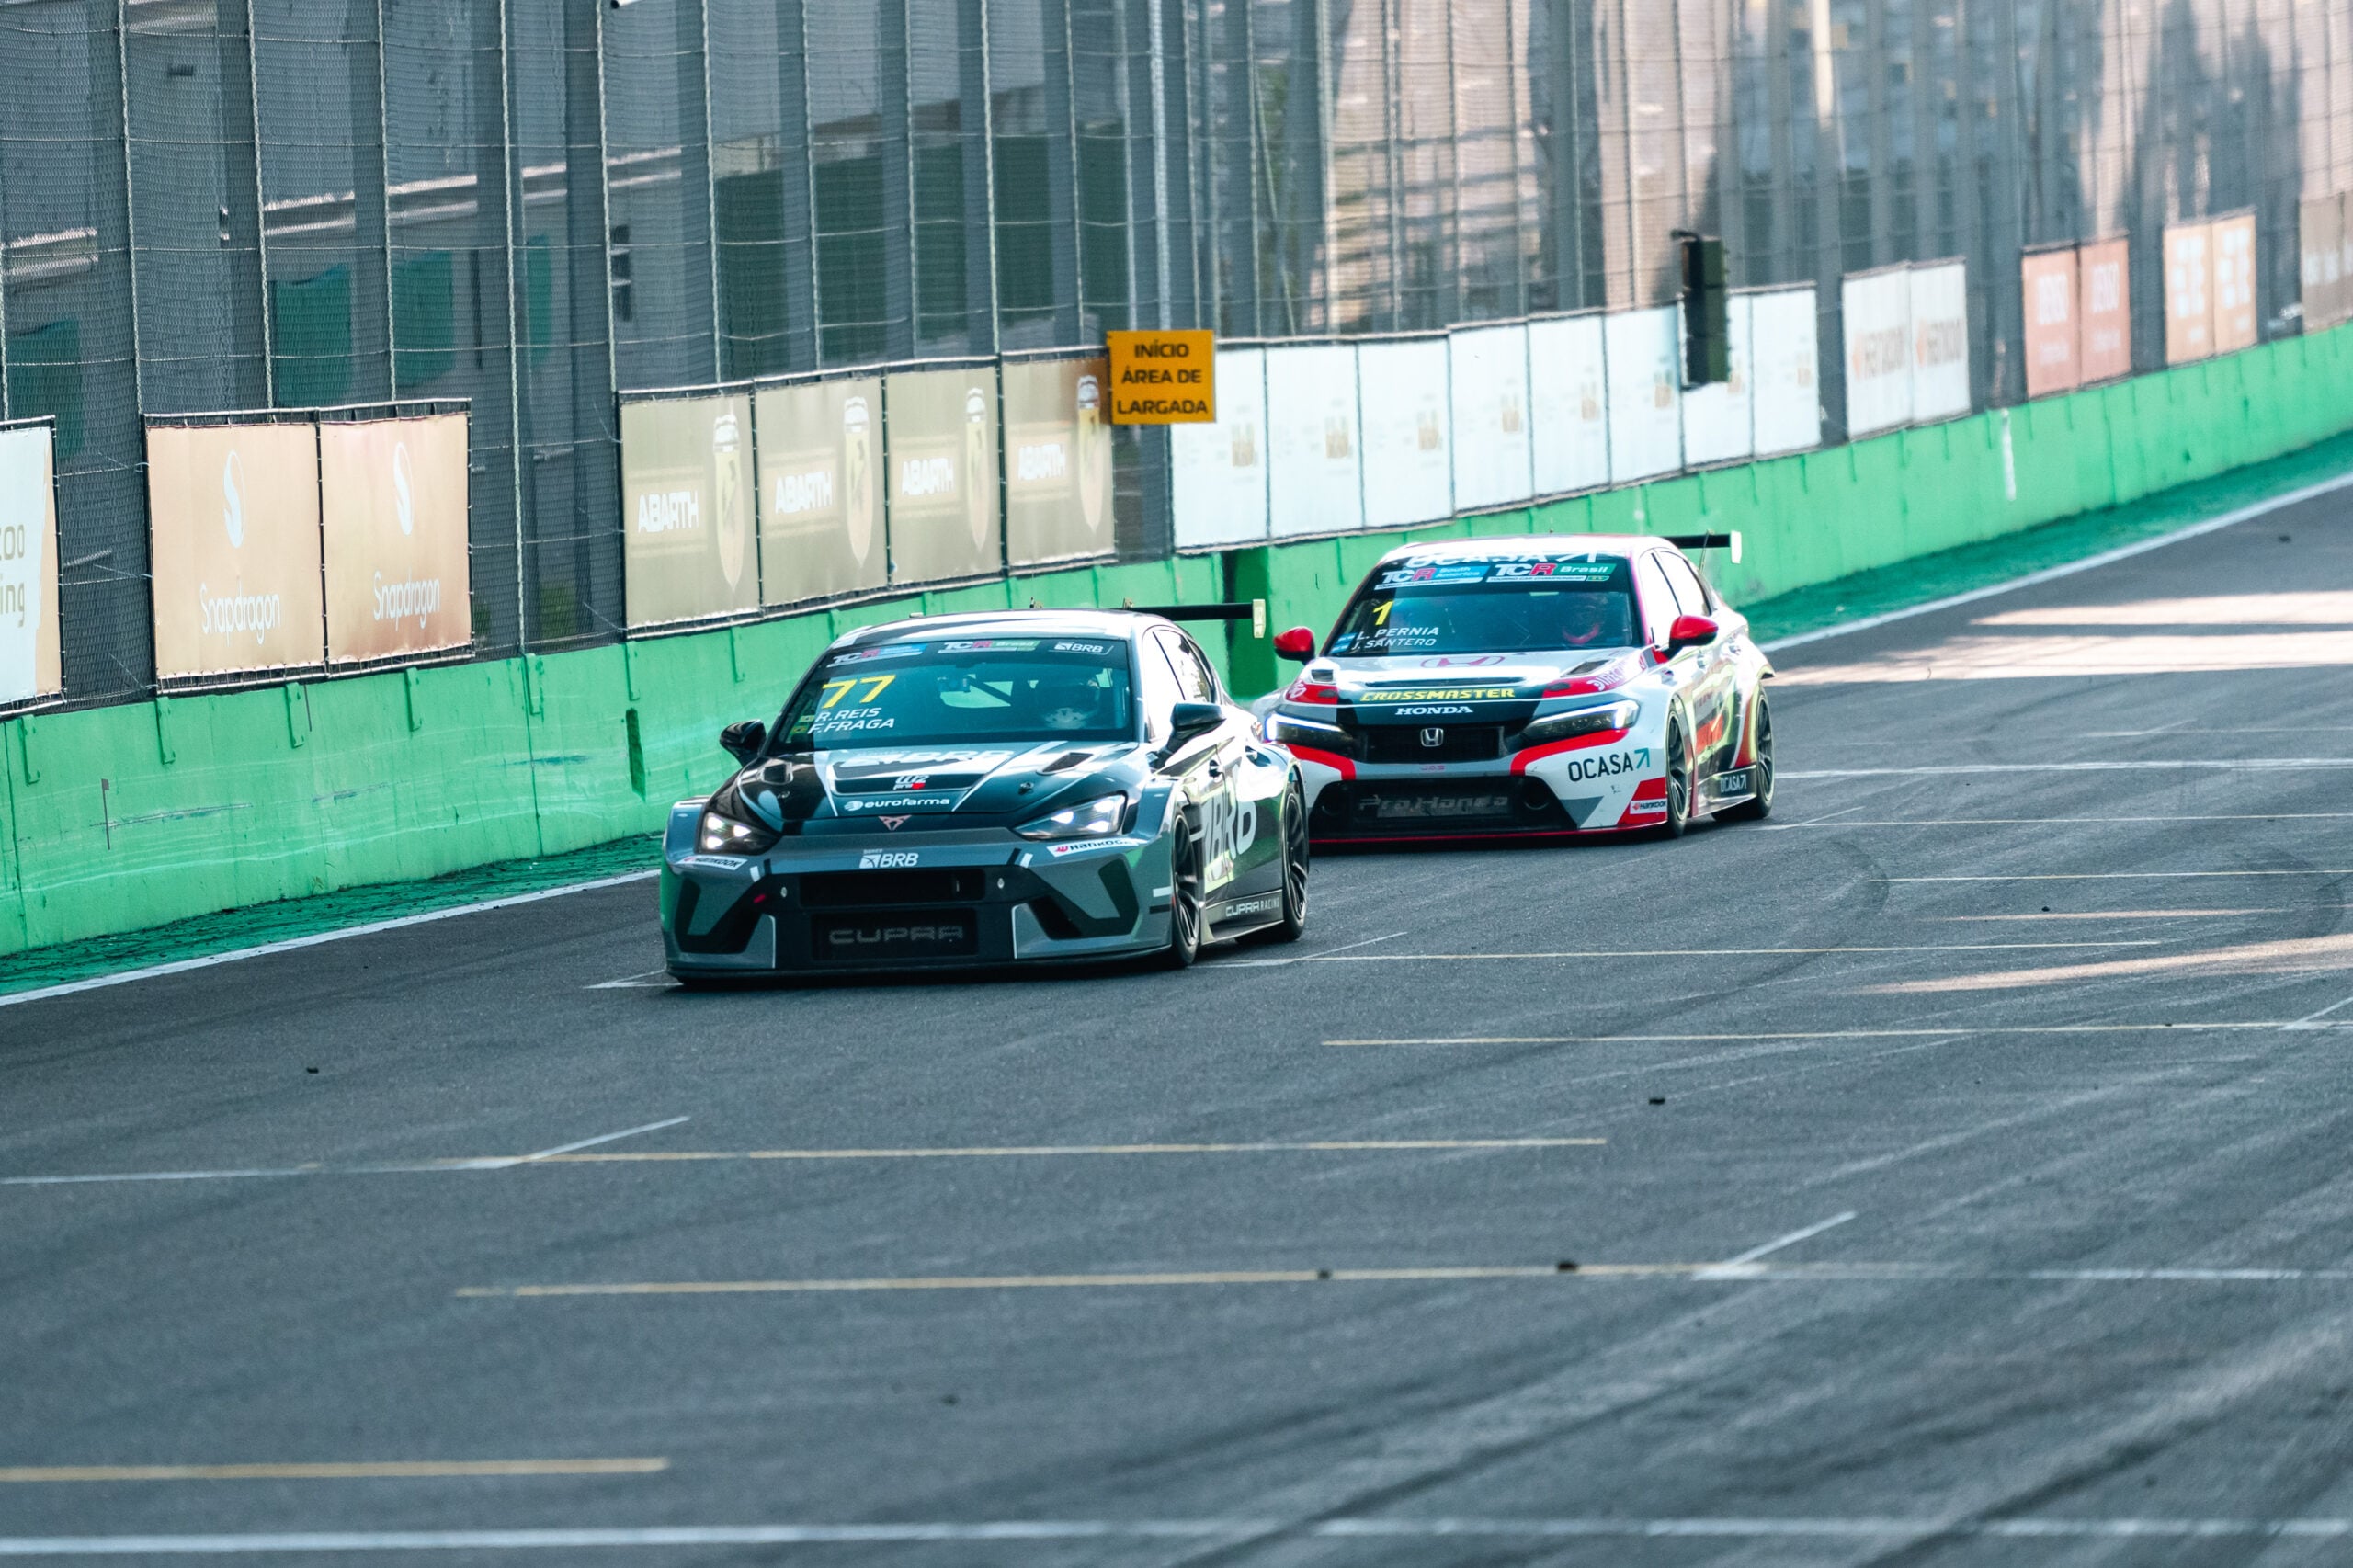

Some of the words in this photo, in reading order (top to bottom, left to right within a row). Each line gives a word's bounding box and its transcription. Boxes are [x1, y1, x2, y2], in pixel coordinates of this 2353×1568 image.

[1134, 338, 1189, 358] INÍCIO
[1121, 365, 1173, 384] ÁREA
[1177, 369, 1202, 384] DE
[1117, 399, 1208, 415] LARGADA
[902, 458, 954, 495] ABARTH
[775, 471, 832, 514] ABARTH
[638, 490, 699, 533] ABARTH
[1381, 567, 1437, 584] TCR
[1495, 562, 1557, 576] TCR
[373, 568, 440, 631] Snapdragon
[200, 581, 281, 647] Snapdragon
[1372, 599, 1394, 626] 1
[1374, 627, 1439, 638] PERNIA
[1071, 643, 1104, 653] BRB
[1364, 638, 1437, 649] SANTERO
[821, 674, 897, 710] 77
[1359, 688, 1516, 702] CROSSMASTER
[814, 707, 882, 722] R.REIS
[1395, 706, 1473, 716] HONDA
[1568, 752, 1634, 783] OCASA
[864, 798, 950, 809] eurofarma
[880, 853, 919, 868] BRB
[1225, 901, 1260, 917] CUPRA
[1260, 897, 1280, 913] RACING
[828, 926, 963, 945] CUPRA
